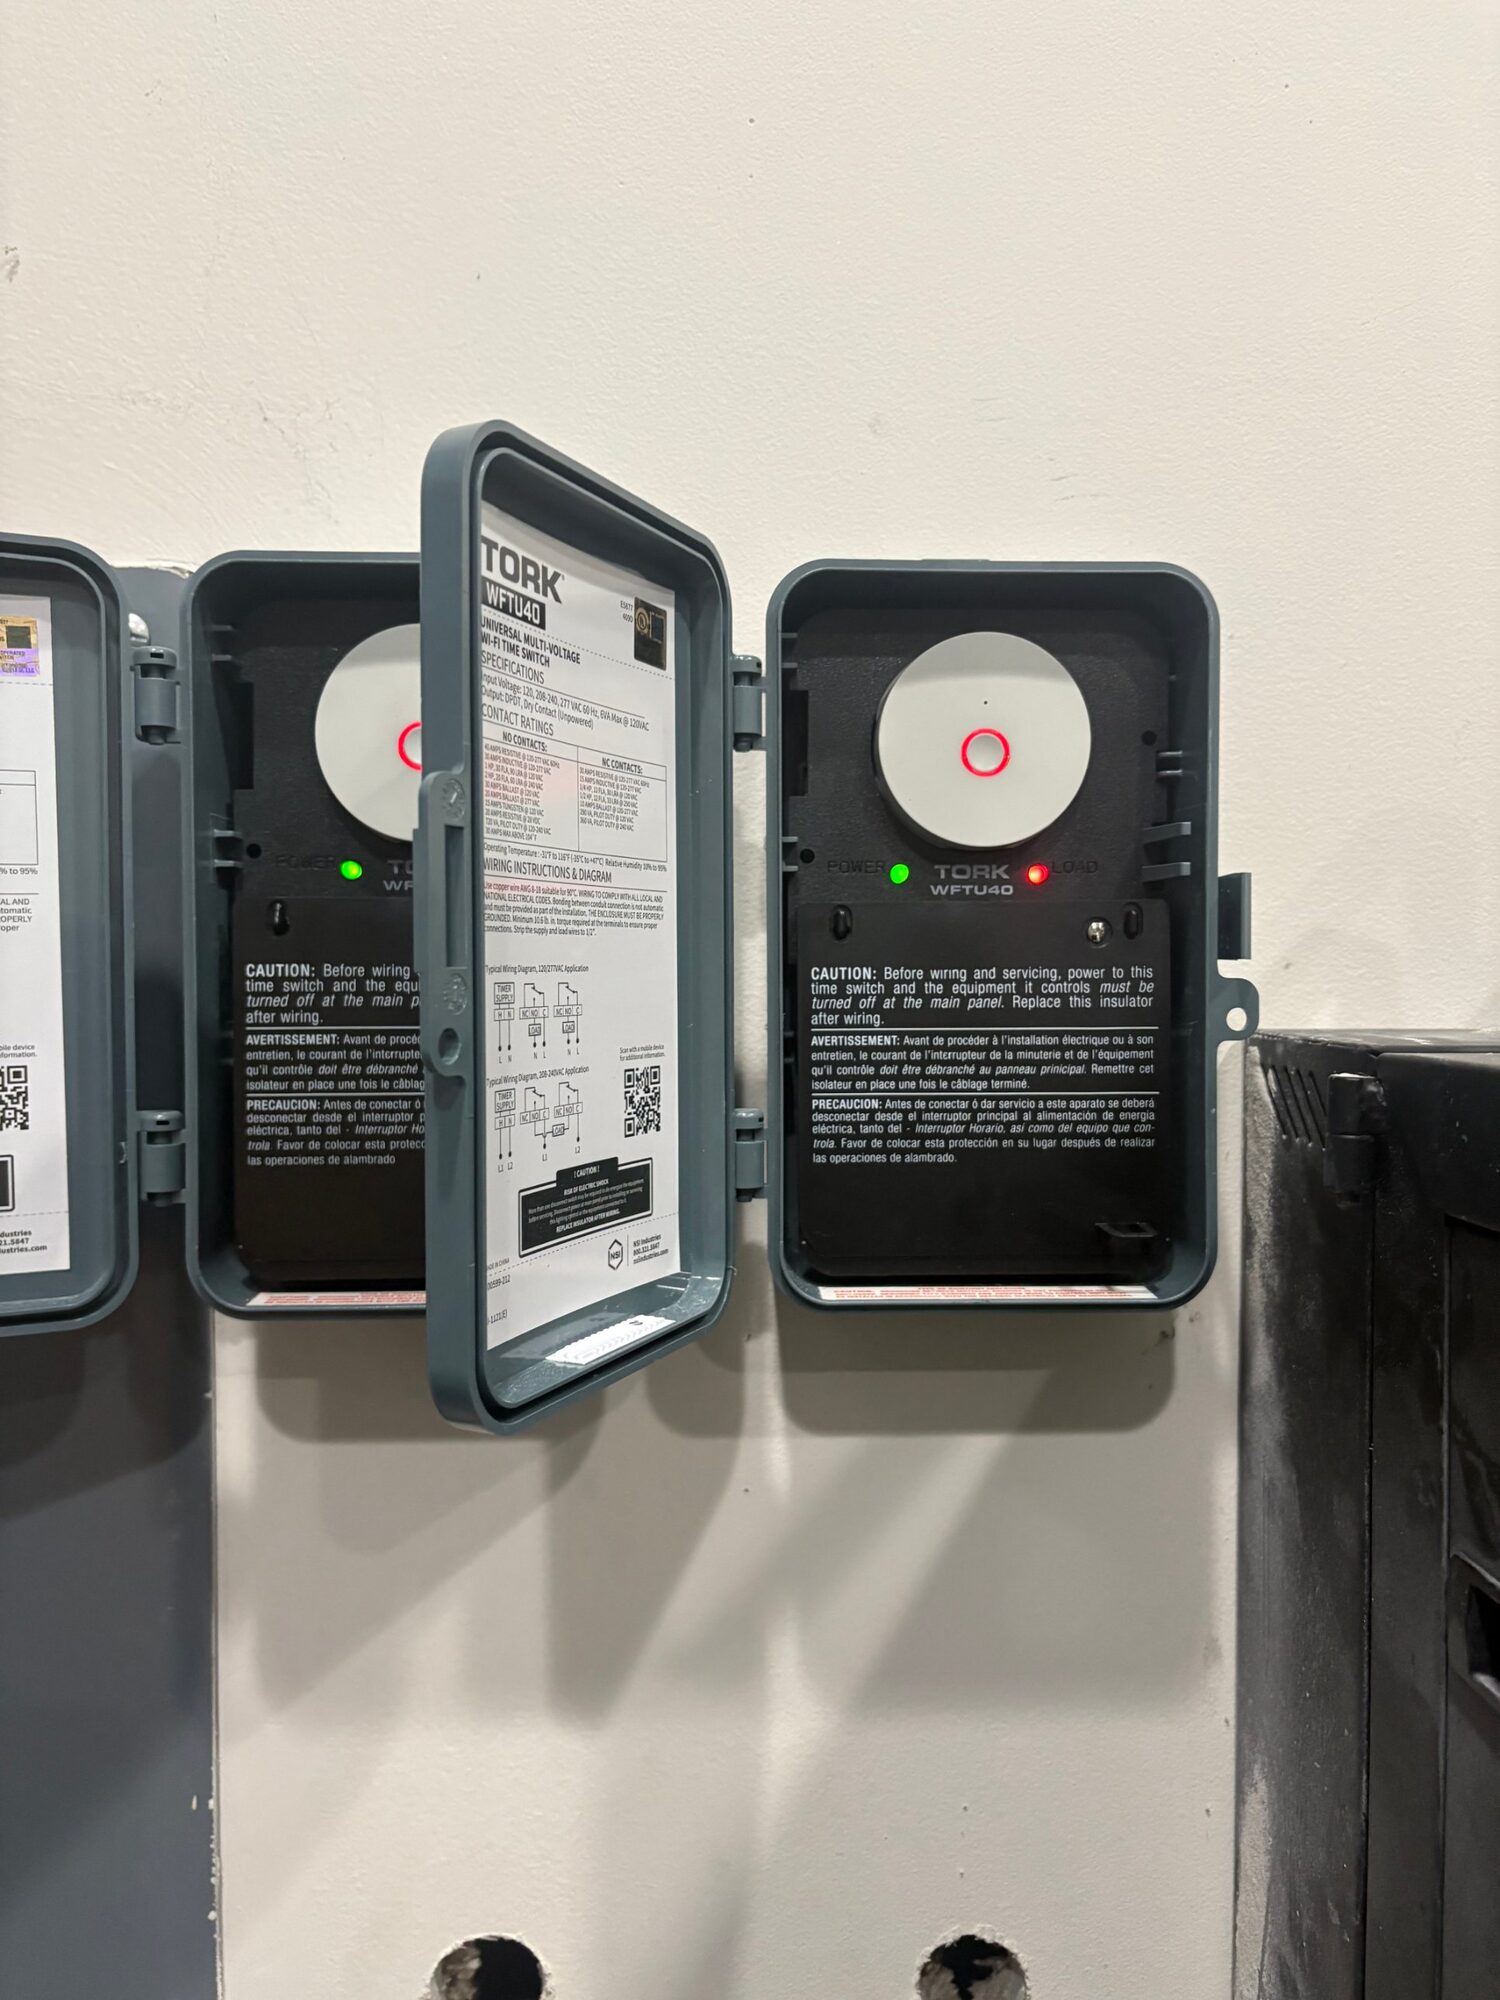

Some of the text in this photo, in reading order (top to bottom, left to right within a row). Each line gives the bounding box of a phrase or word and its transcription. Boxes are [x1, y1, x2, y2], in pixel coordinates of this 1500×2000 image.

[481, 536, 562, 604] TORK
[486, 582, 540, 625] WFTU40
[481, 616, 580, 665] UNIVERSAL MULTI-VOLTAGE
[481, 632, 550, 668] WI-FI TIME SWITCH
[482, 651, 544, 685] SPECIFICATIONS
[497, 676, 522, 694] Voltage:
[481, 704, 554, 737] CONTACT RATINGS
[502, 731, 547, 752] NO CONTACTS:
[602, 757, 643, 774] NC CONTACTS:
[482, 857, 612, 883] WIRING INSTRUCTIONS & DIAGRAM
[827, 860, 885, 874] POWER
[934, 864, 1010, 880] TORK
[1052, 860, 1098, 874] LOAD
[930, 885, 1013, 895] WFTU40
[246, 963, 410, 980] CAUTION: Before wiring
[811, 965, 1153, 982] CAUTION: Before wiring and servicing, power to this
[245, 979, 386, 992] time switch and the
[811, 981, 1154, 997] time switch and the equipment it controls must be
[246, 994, 403, 1007] turned off at the main
[812, 995, 1153, 1011] turned off at the main panel. Replace this insulator
[245, 1010, 323, 1026] after wiring.
[811, 1011, 885, 1027] after wiring.
[811, 1035, 900, 1046] AVERTISSEMENT:
[903, 1035, 930, 1046] Avant
[932, 1035, 945, 1046] de
[947, 1035, 989, 1047] procéder
[1062, 1034, 1109, 1046] électrique
[1112, 1036, 1124, 1045] ou
[1137, 1036, 1153, 1044] son
[859, 1050, 868, 1061] le
[870, 1050, 907, 1060] courant
[909, 1050, 922, 1060] de
[989, 1049, 1002, 1060] de
[1004, 1049, 1013, 1060] la
[1016, 1049, 1061, 1060] minuterie
[1064, 1050, 1074, 1060] et
[1076, 1049, 1089, 1060] de
[836, 1064, 875, 1075] contrôle
[880, 1064, 898, 1075] doit
[902, 1064, 921, 1075] être
[925, 1064, 975, 1075] débranché
[979, 1065, 991, 1075] au
[995, 1065, 1037, 1076] panneau
[1091, 1063, 1135, 1074] Remettre
[1139, 1064, 1154, 1074] cet
[812, 1079, 853, 1090] isolateur
[855, 1081, 867, 1090] en
[870, 1079, 896, 1091] place
[898, 1080, 916, 1090] une
[919, 1079, 937, 1090] fois
[939, 1079, 948, 1089] le
[884, 1099, 912, 1109] Antes
[914, 1099, 926, 1109] de
[928, 1099, 969, 1109] conectar
[980, 1098, 996, 1109] dar
[998, 1098, 1035, 1109] servicio
[1038, 1100, 1044, 1109] a
[1046, 1099, 1067, 1109] este
[1069, 1099, 1105, 1110] aparato
[1108, 1100, 1119, 1108] se
[1122, 1098, 1154, 1108] deberá
[812, 1153, 827, 1163] las
[829, 1153, 887, 1165] operaciones
[890, 1152, 902, 1163] de
[576, 1166, 597, 1178] CAUTION
[610, 1250, 621, 1260] NSI
